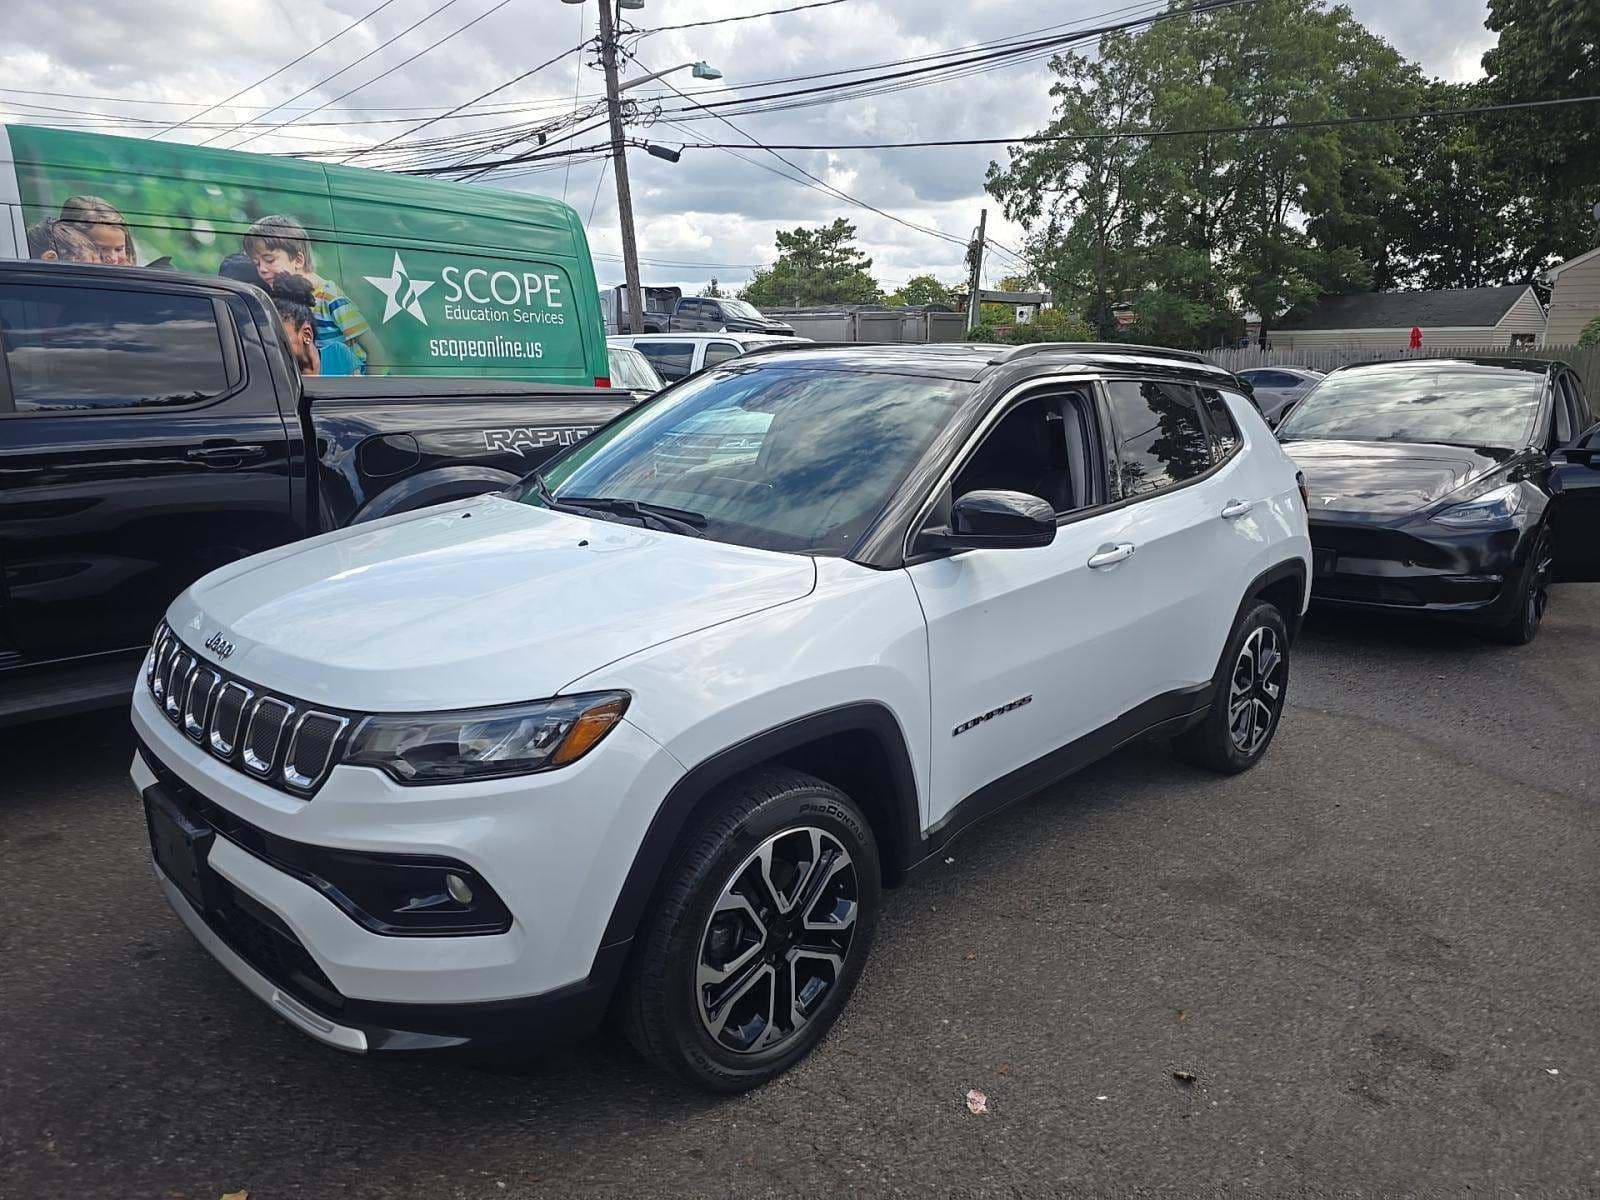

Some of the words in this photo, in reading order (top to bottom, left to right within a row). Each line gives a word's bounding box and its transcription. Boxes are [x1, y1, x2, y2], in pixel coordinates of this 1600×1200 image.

[441, 266, 563, 308] SCOPE
[444, 305, 509, 323] Education
[513, 309, 564, 325] Services
[430, 336, 543, 361] scopeonline.us
[483, 425, 601, 457] RAPTO
[205, 631, 236, 662] Jeep
[952, 694, 1033, 737] COMPASS
